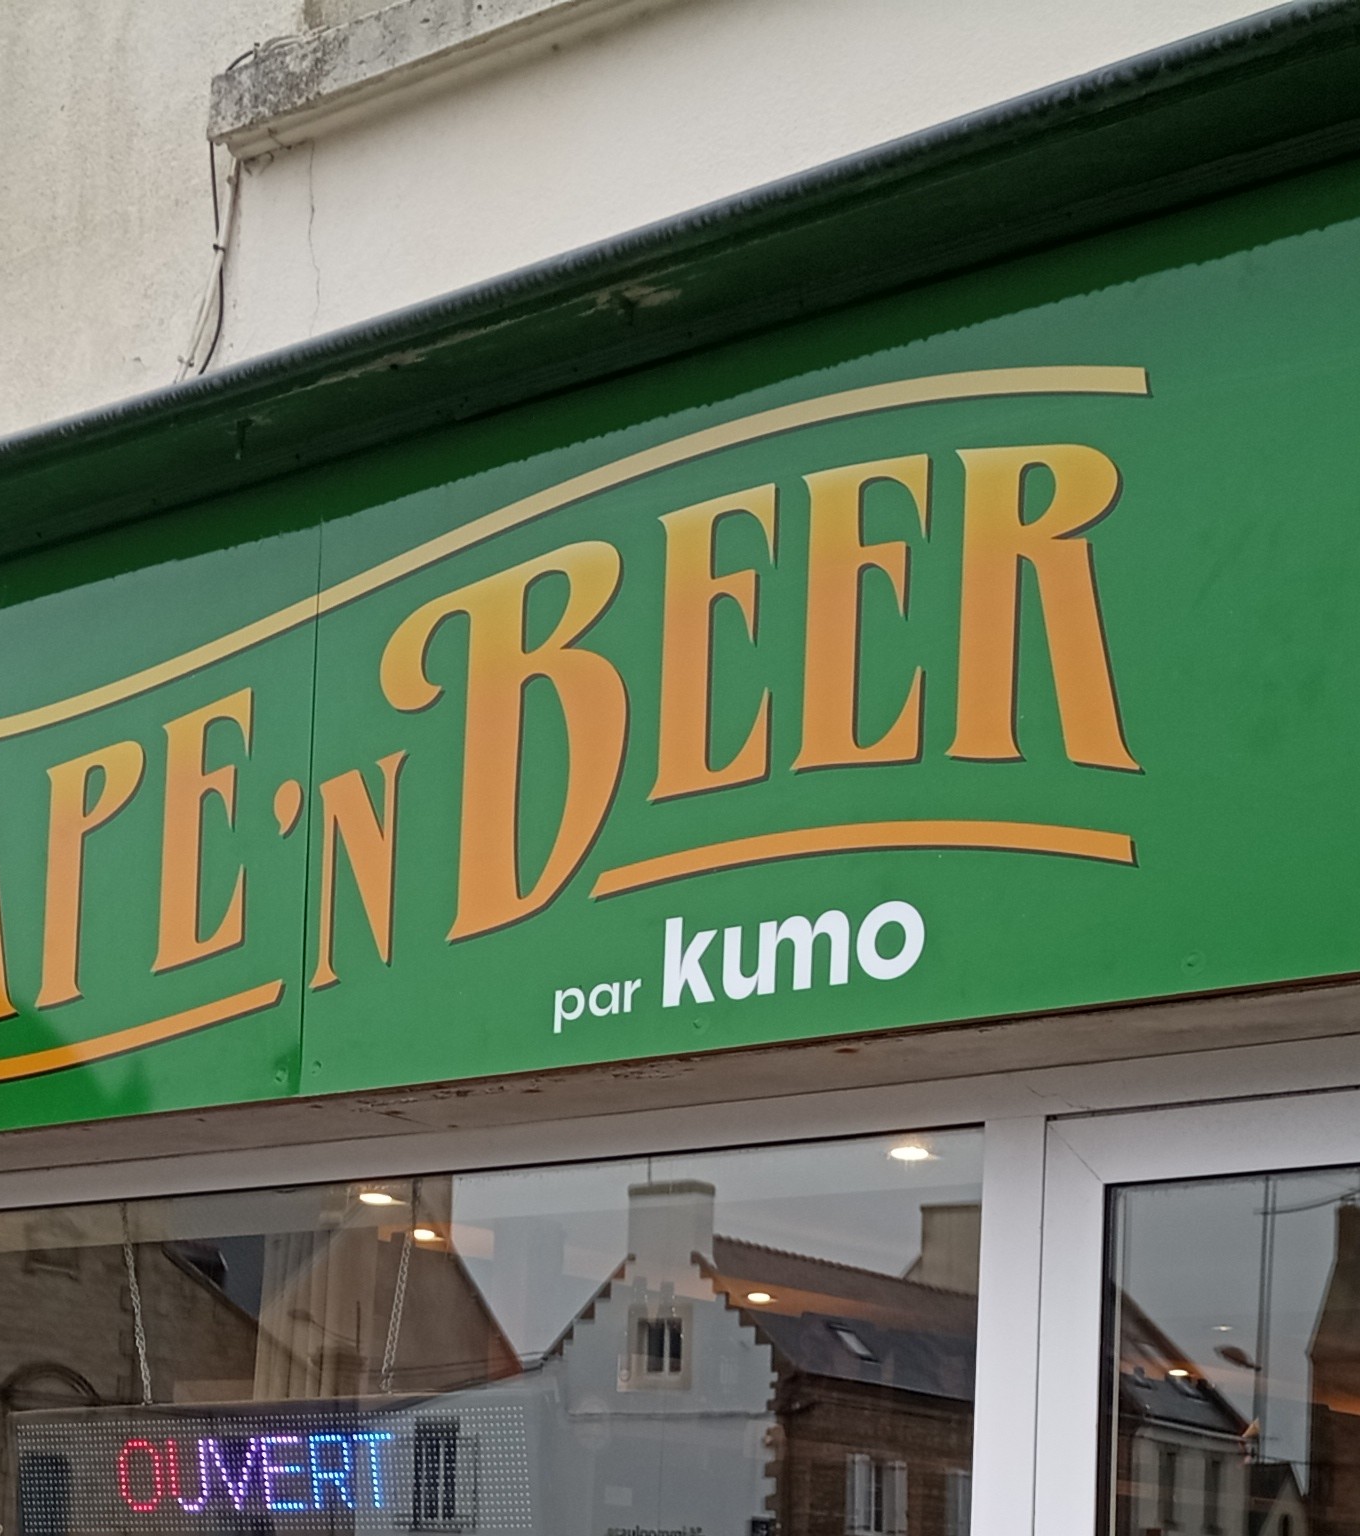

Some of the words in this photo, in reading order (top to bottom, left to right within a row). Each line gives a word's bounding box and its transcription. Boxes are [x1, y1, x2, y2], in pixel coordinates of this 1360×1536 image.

[378, 442, 1143, 948] BEER
[552, 975, 643, 1035] par
[662, 899, 926, 1009] kumo
[118, 1431, 395, 1513] OUVERT
